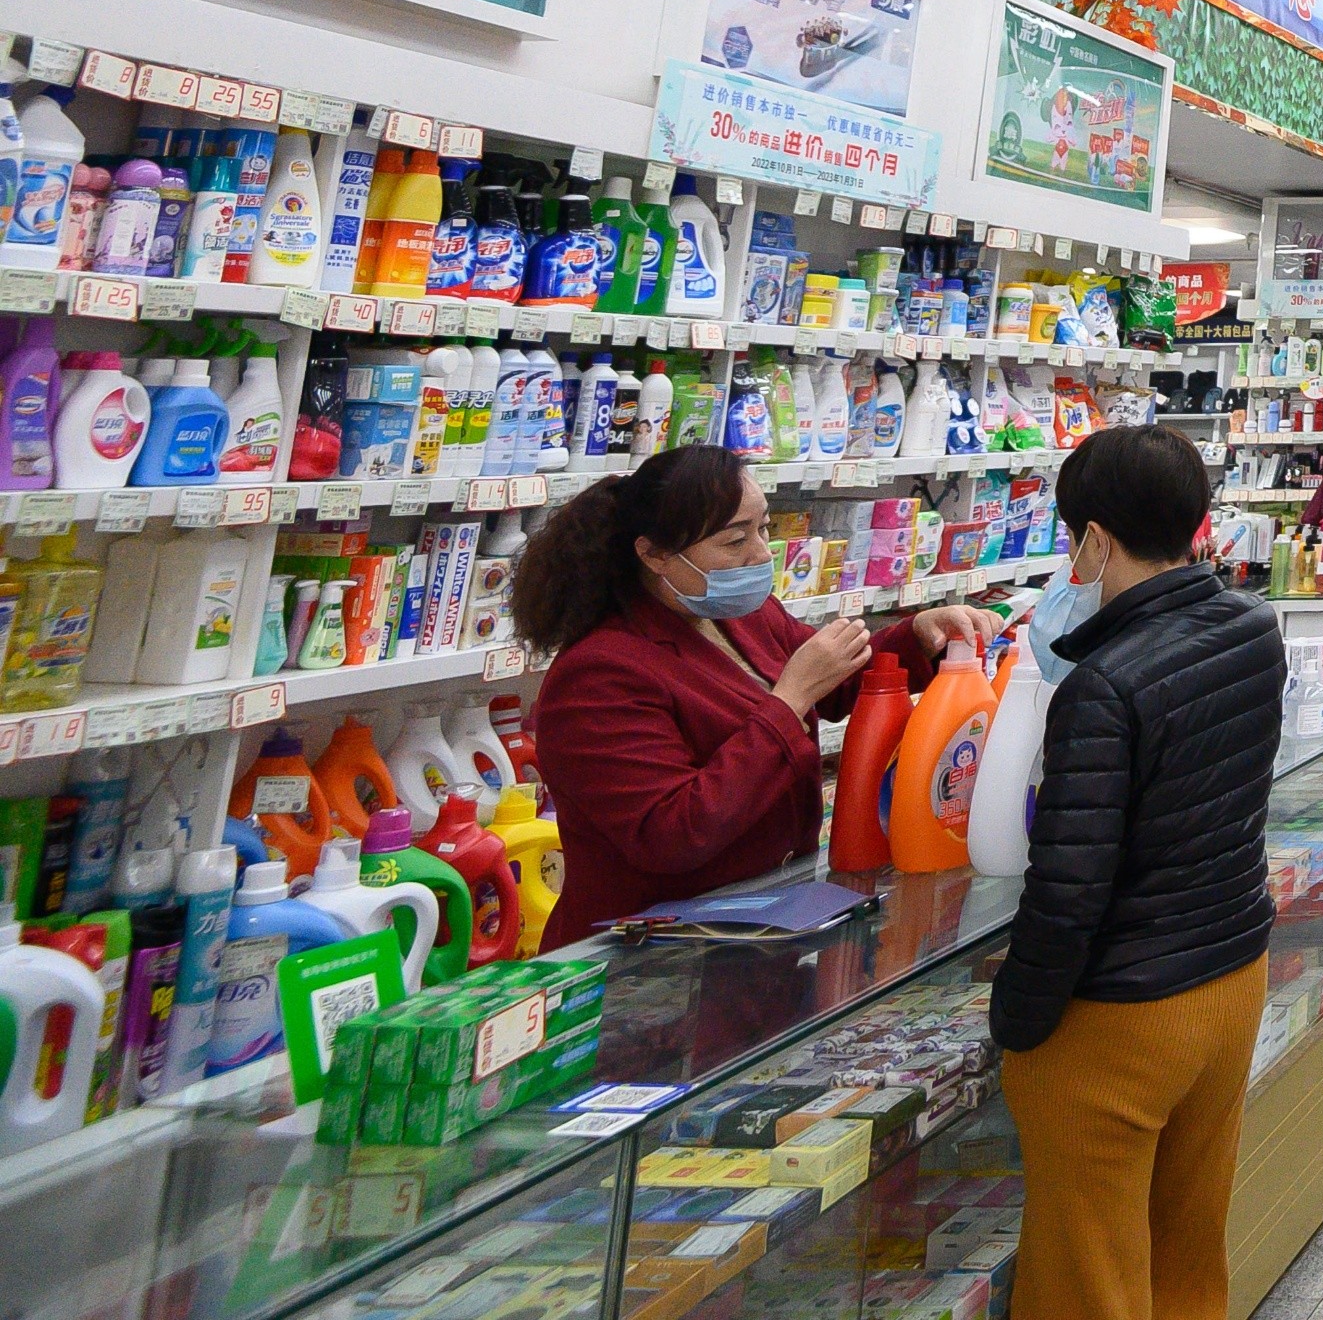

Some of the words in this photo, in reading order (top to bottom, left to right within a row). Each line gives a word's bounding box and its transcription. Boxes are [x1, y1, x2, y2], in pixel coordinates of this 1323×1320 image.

[179, 76, 194, 96] 8
[212, 84, 237, 104] 25
[702, 82, 808, 121] 进价销售本市独一
[826, 114, 915, 149] 优惠幅度省内无二
[440, 551, 470, 646] White&White
[505, 649, 521, 667] 25
[526, 1003, 539, 1033] 5
